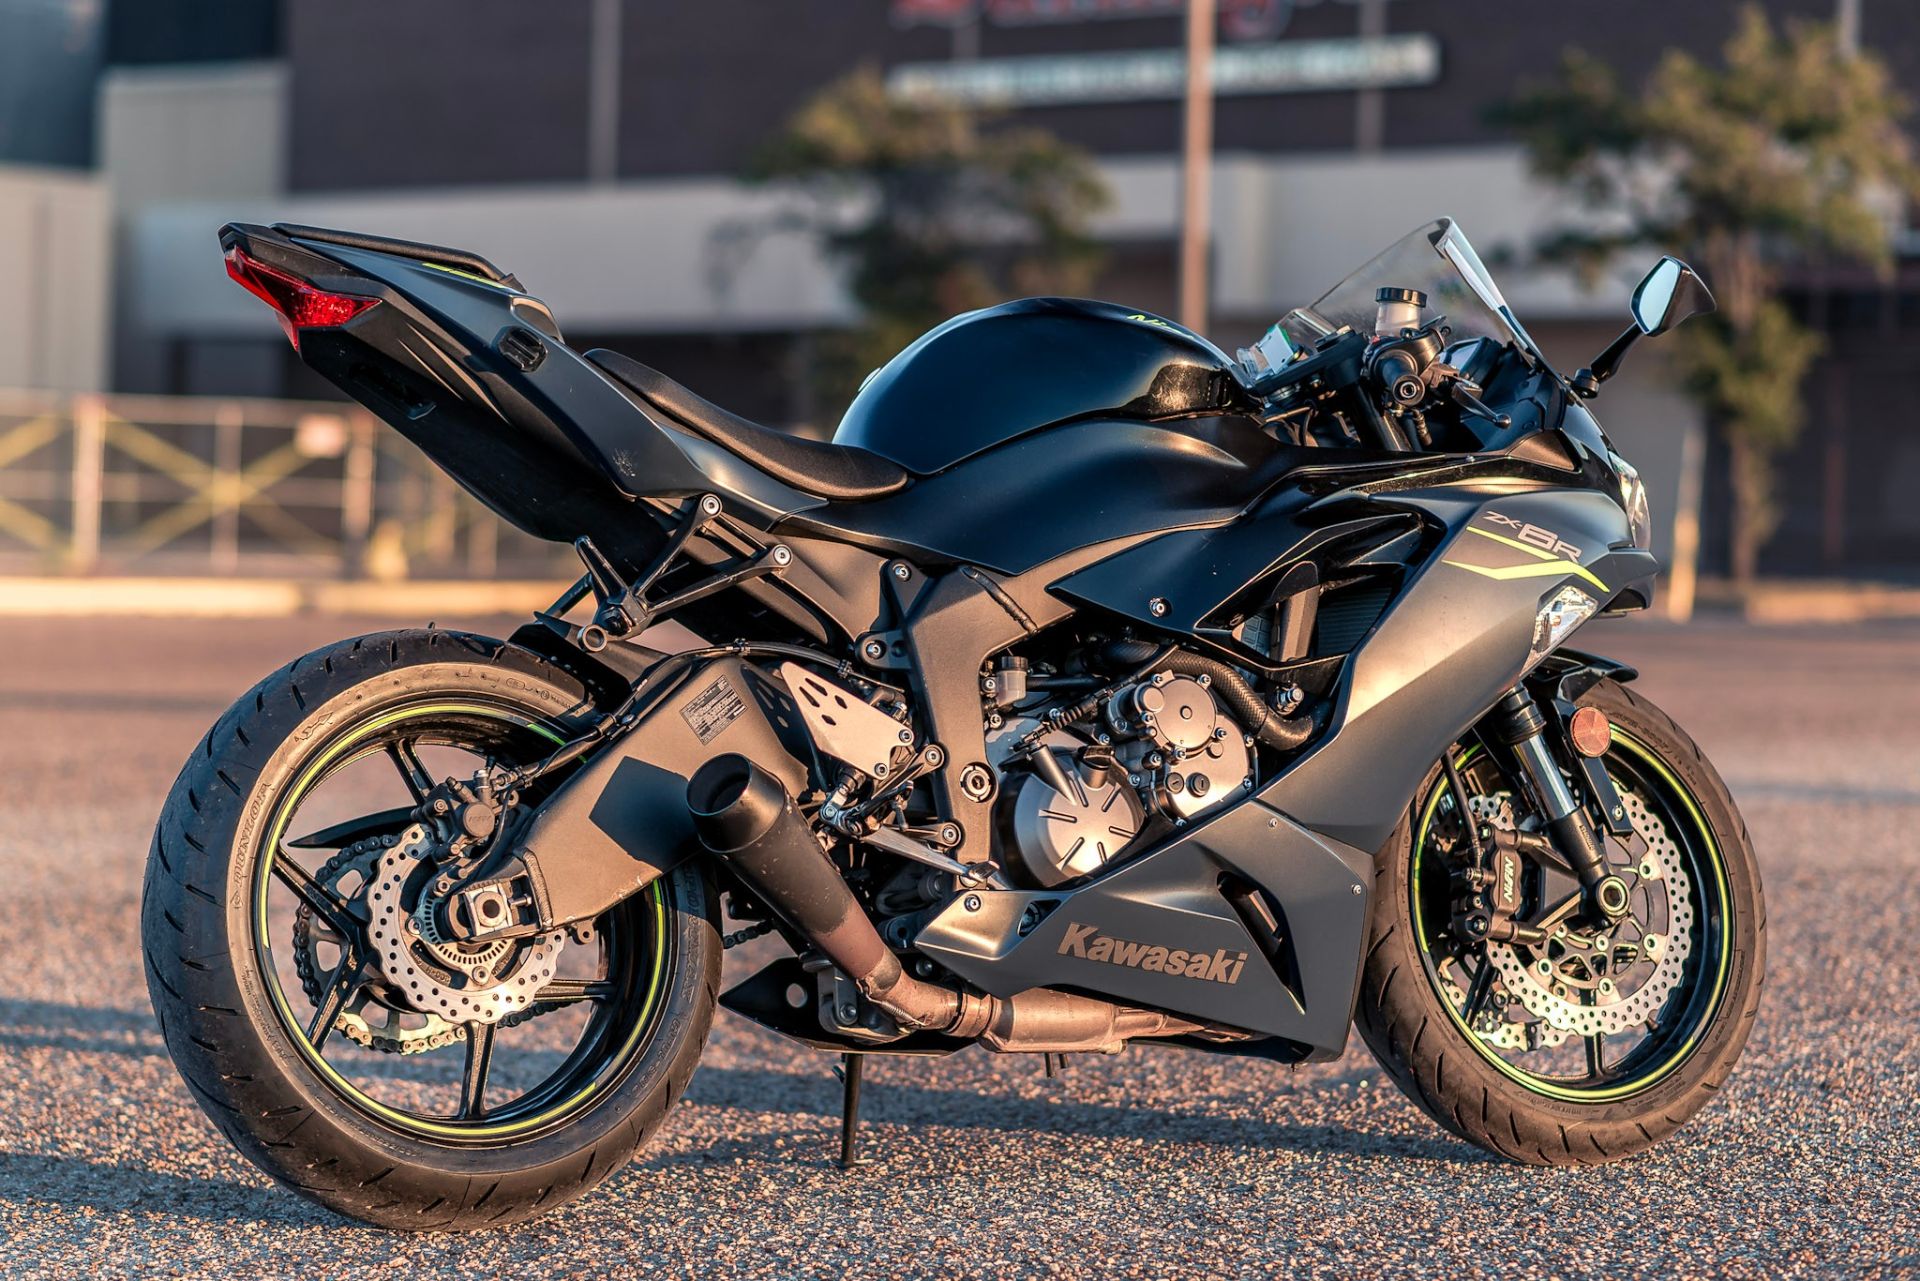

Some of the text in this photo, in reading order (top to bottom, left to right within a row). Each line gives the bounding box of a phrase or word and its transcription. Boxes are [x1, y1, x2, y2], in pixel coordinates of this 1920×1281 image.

[1483, 510, 1583, 564] ZX-6R
[233, 783, 272, 887] DUNLOP
[1057, 921, 1249, 985] Kawasaki
